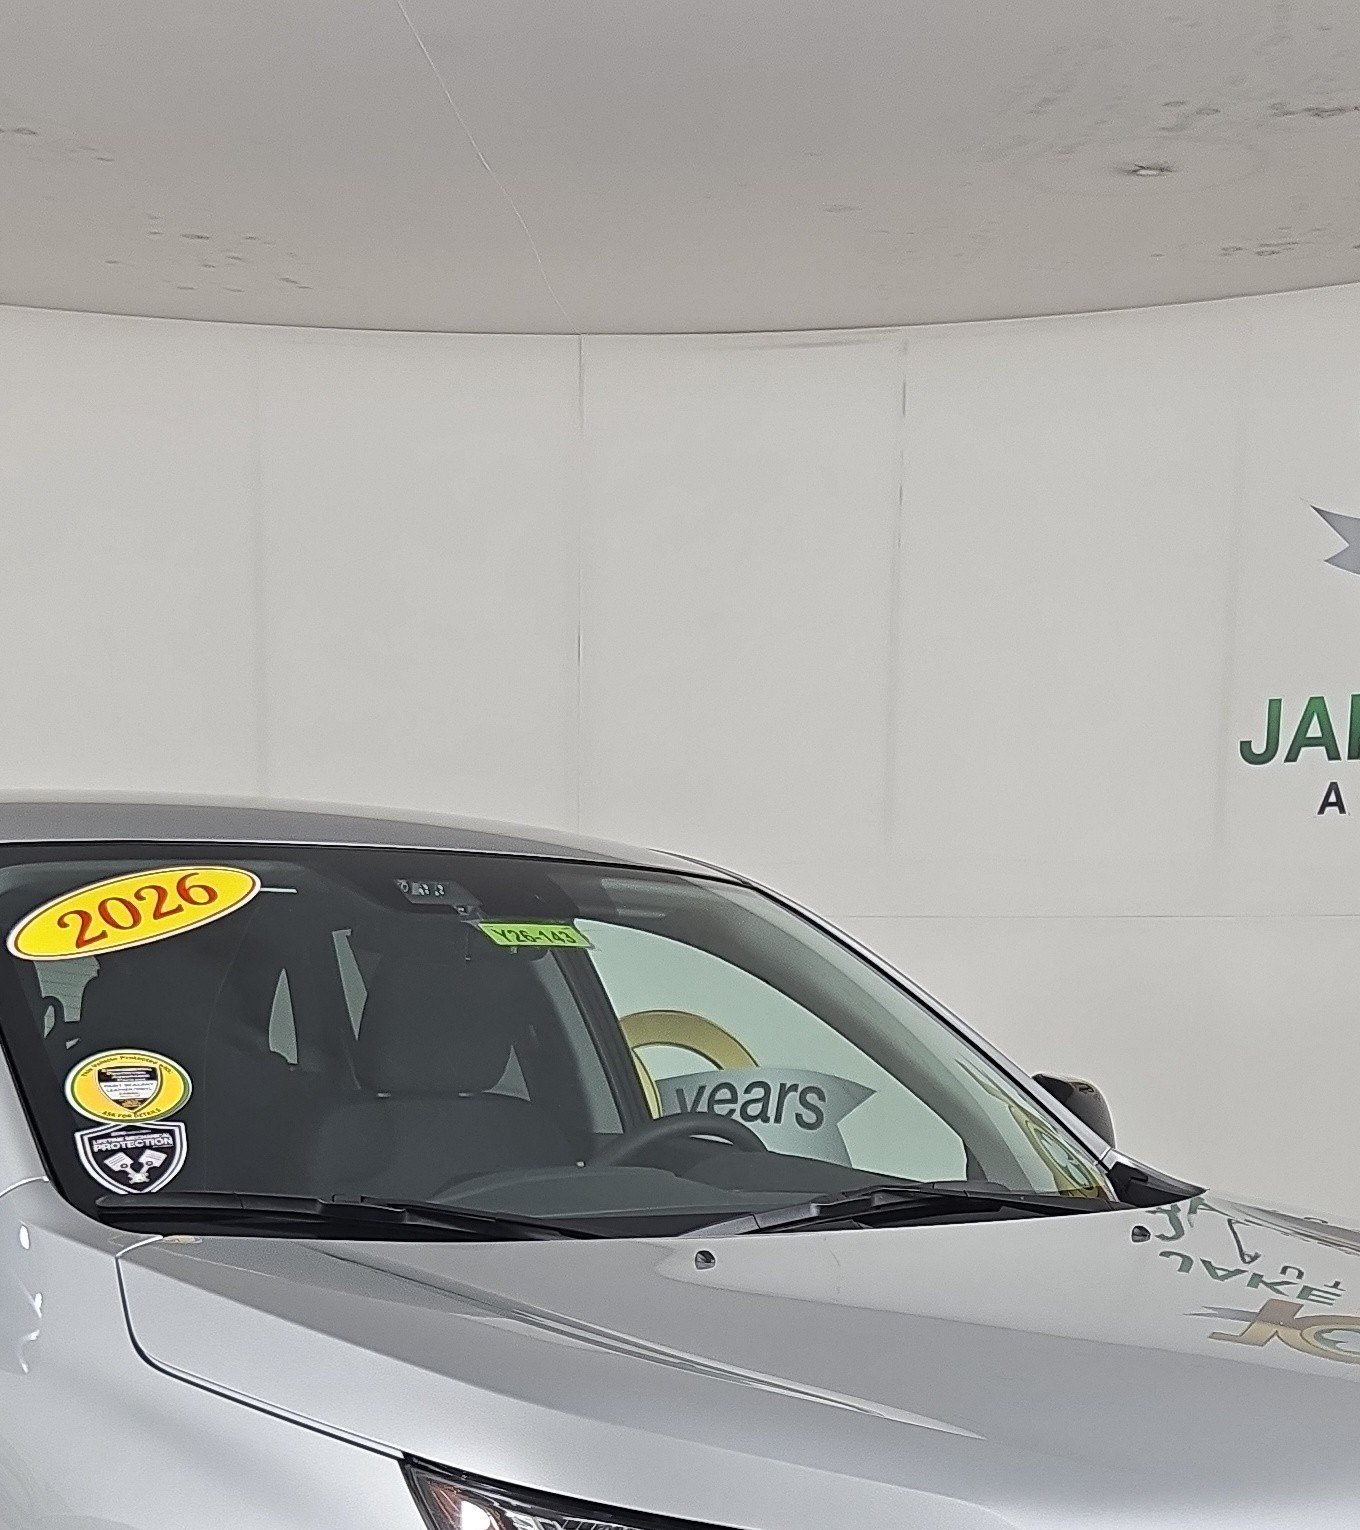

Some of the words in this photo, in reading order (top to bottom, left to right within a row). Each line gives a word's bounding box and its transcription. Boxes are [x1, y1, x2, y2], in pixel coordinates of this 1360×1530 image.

[56, 871, 220, 950] 2026
[490, 928, 577, 944] Y26-143
[92, 1137, 174, 1153] PROTECTION
